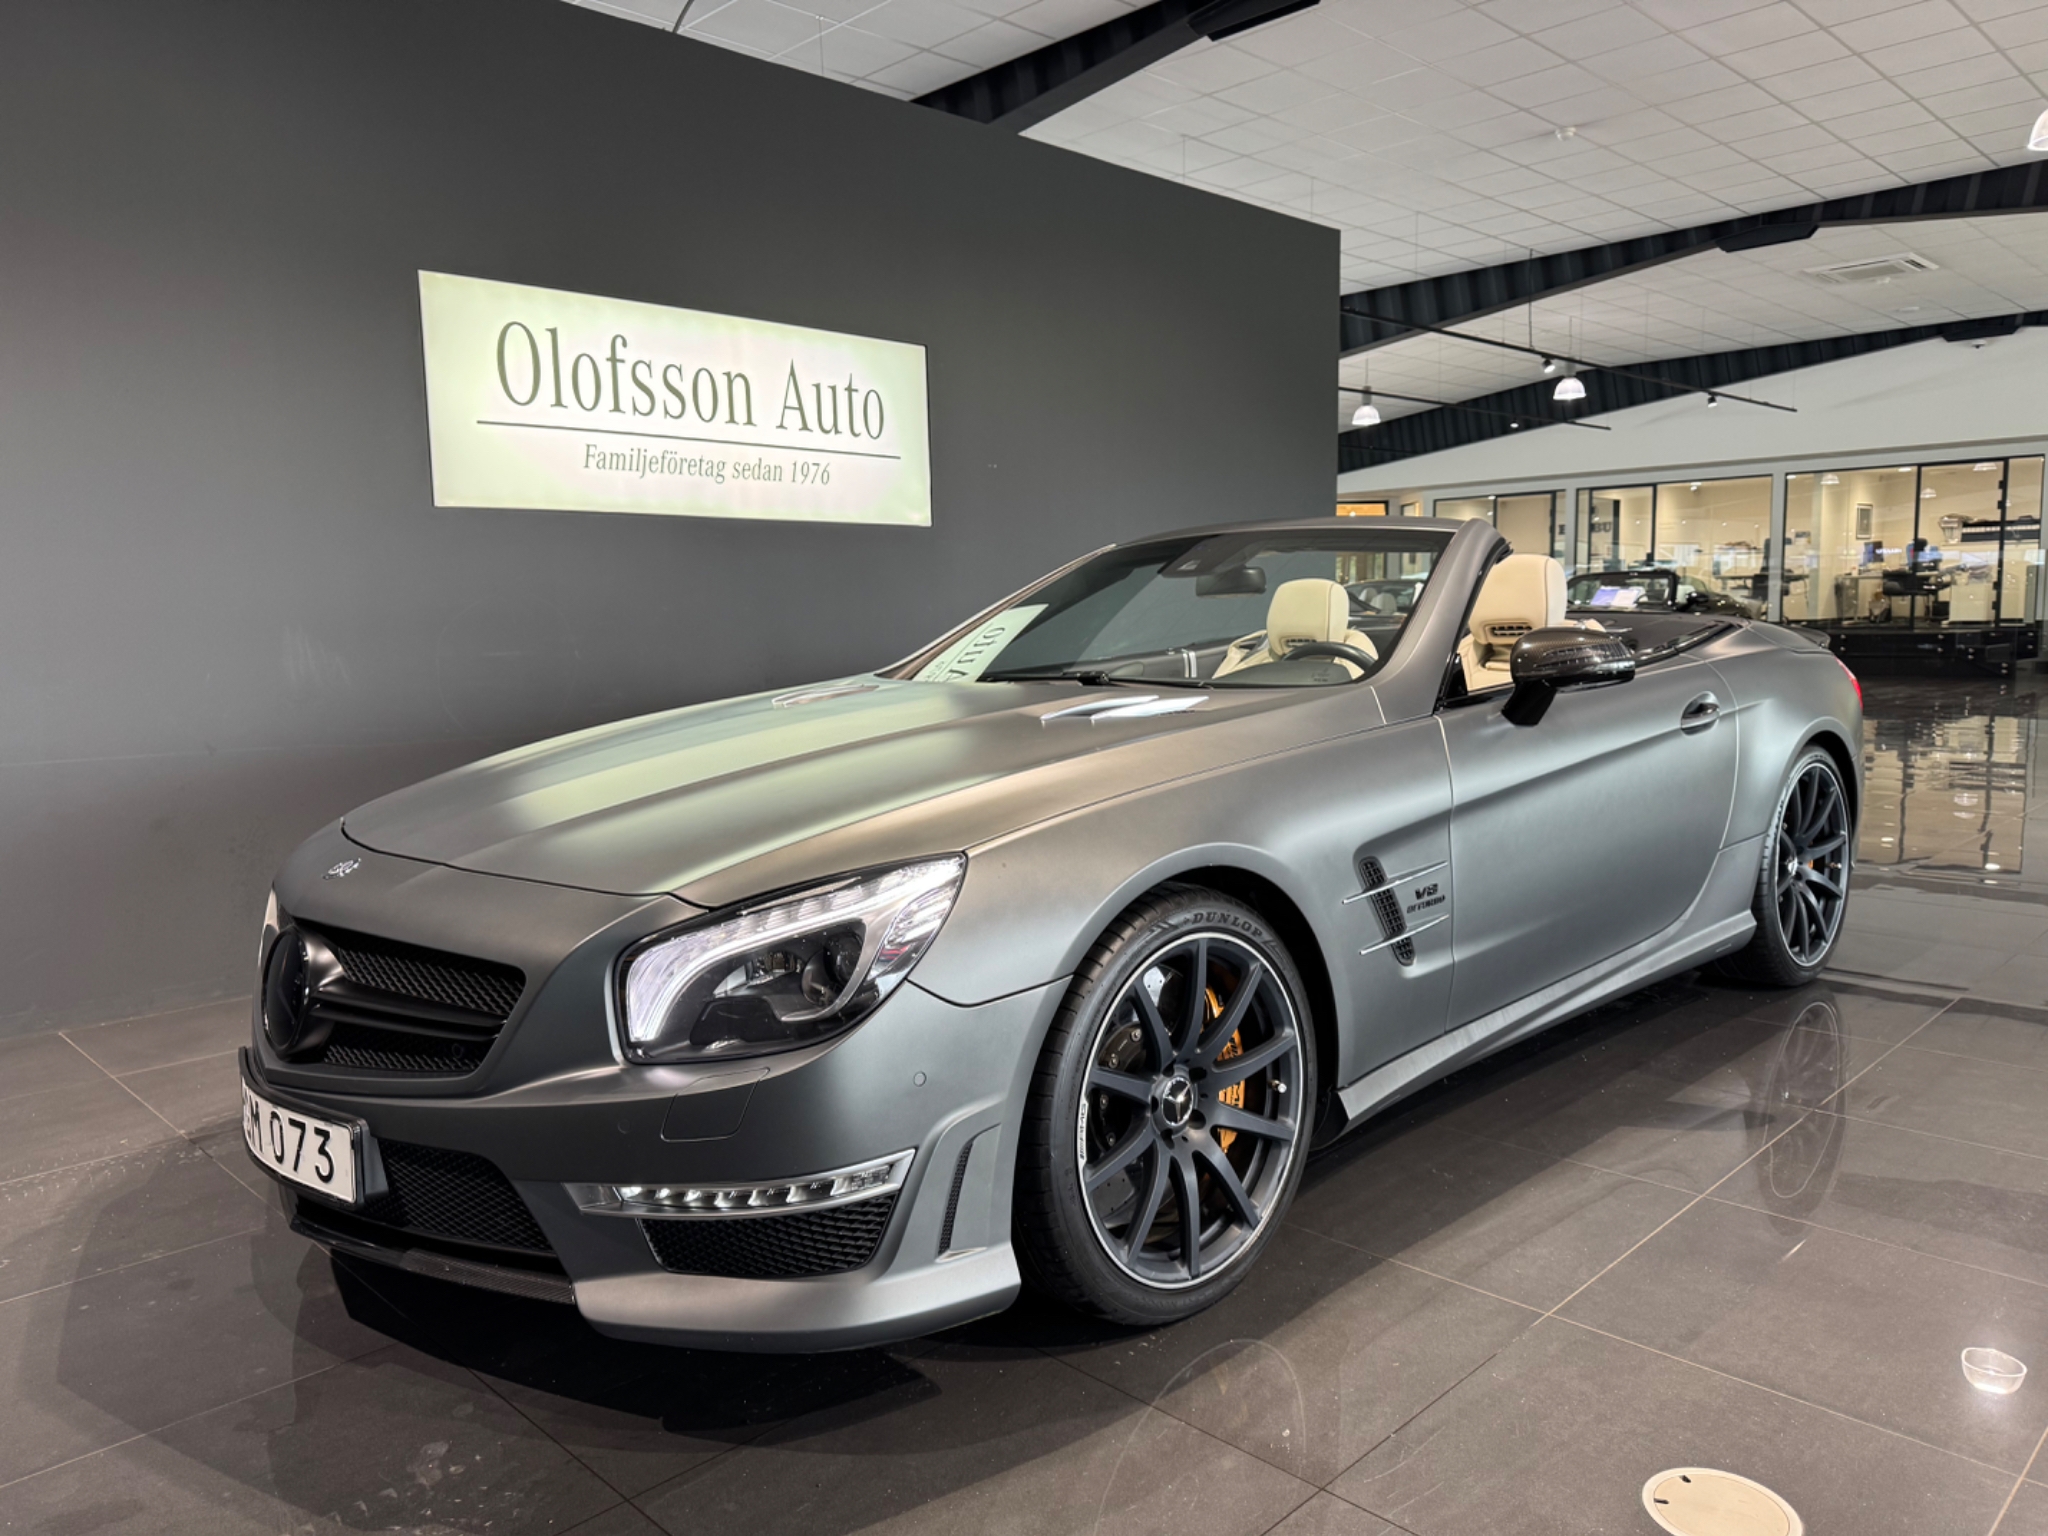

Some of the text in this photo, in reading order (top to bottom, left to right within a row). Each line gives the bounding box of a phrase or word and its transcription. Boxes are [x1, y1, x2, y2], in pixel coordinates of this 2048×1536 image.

[496, 321, 885, 440] Olofsson Auto
[583, 443, 831, 486] Familjeföretag sedan 1976
[1192, 911, 1263, 939] DUNLOP
